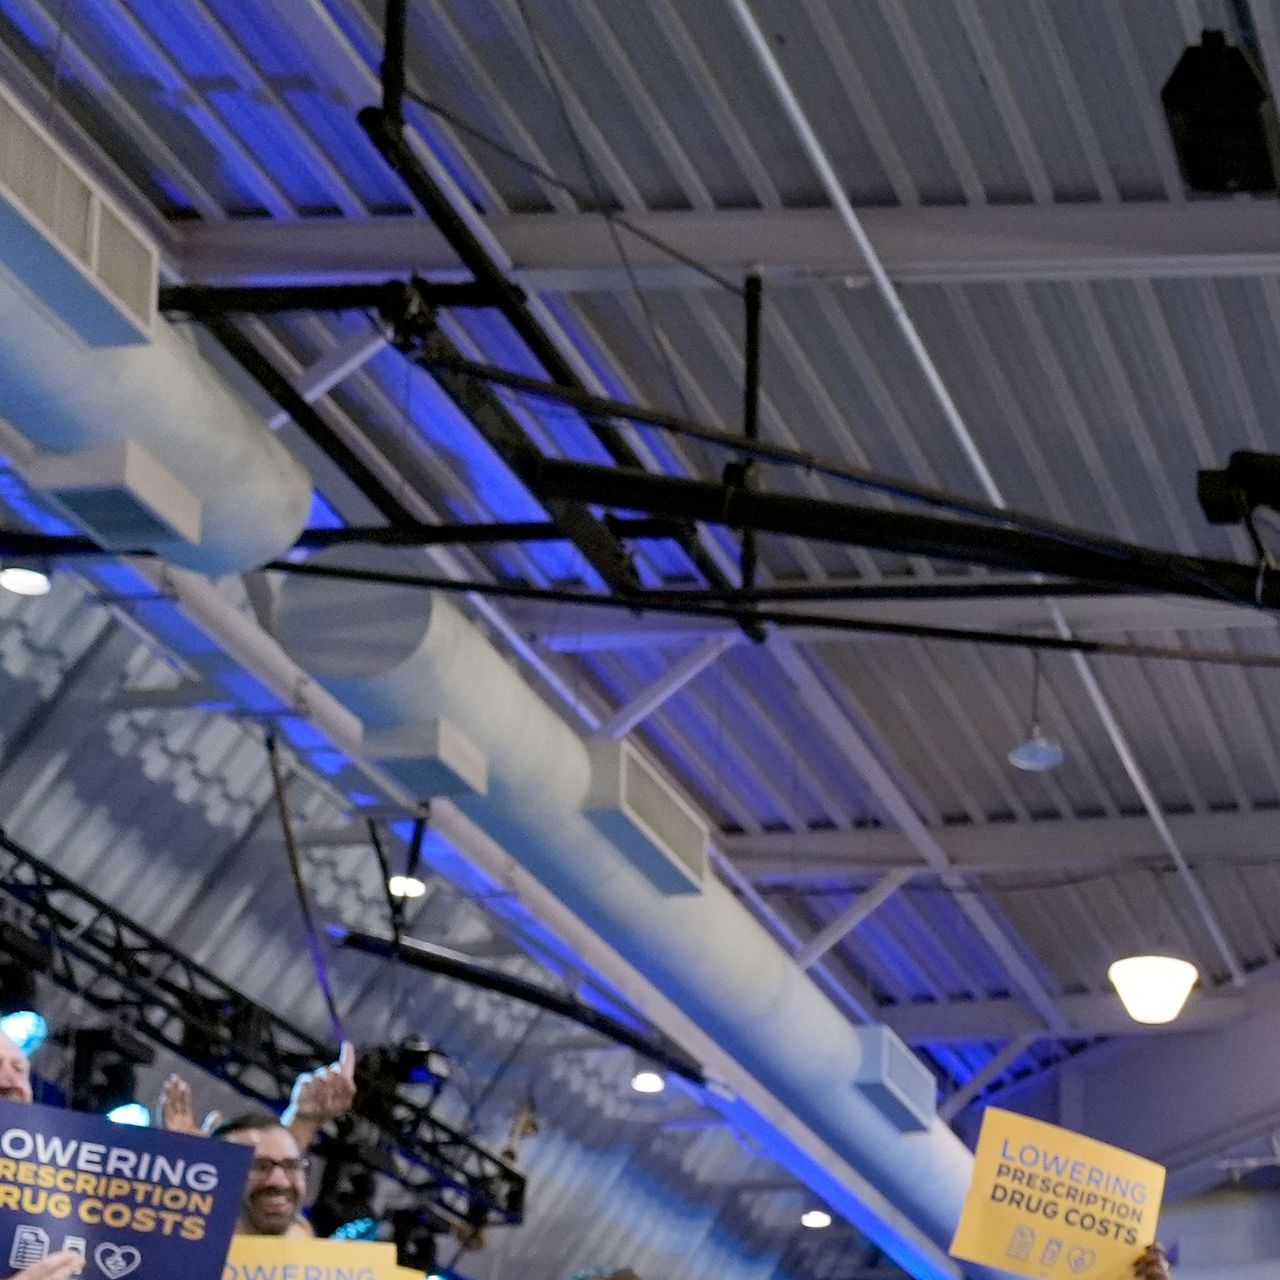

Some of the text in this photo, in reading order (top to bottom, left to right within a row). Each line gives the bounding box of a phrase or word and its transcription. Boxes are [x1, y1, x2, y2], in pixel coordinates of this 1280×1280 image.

[0, 1157, 214, 1215] RESCRIPTION
[1, 1128, 219, 1192] OWERING
[1001, 1138, 1148, 1205] LOWERING
[0, 1183, 206, 1241] RUG COSTS
[990, 1183, 1139, 1246] DRUG COSTS
[996, 1163, 1144, 1224] PRESCRIPTION
